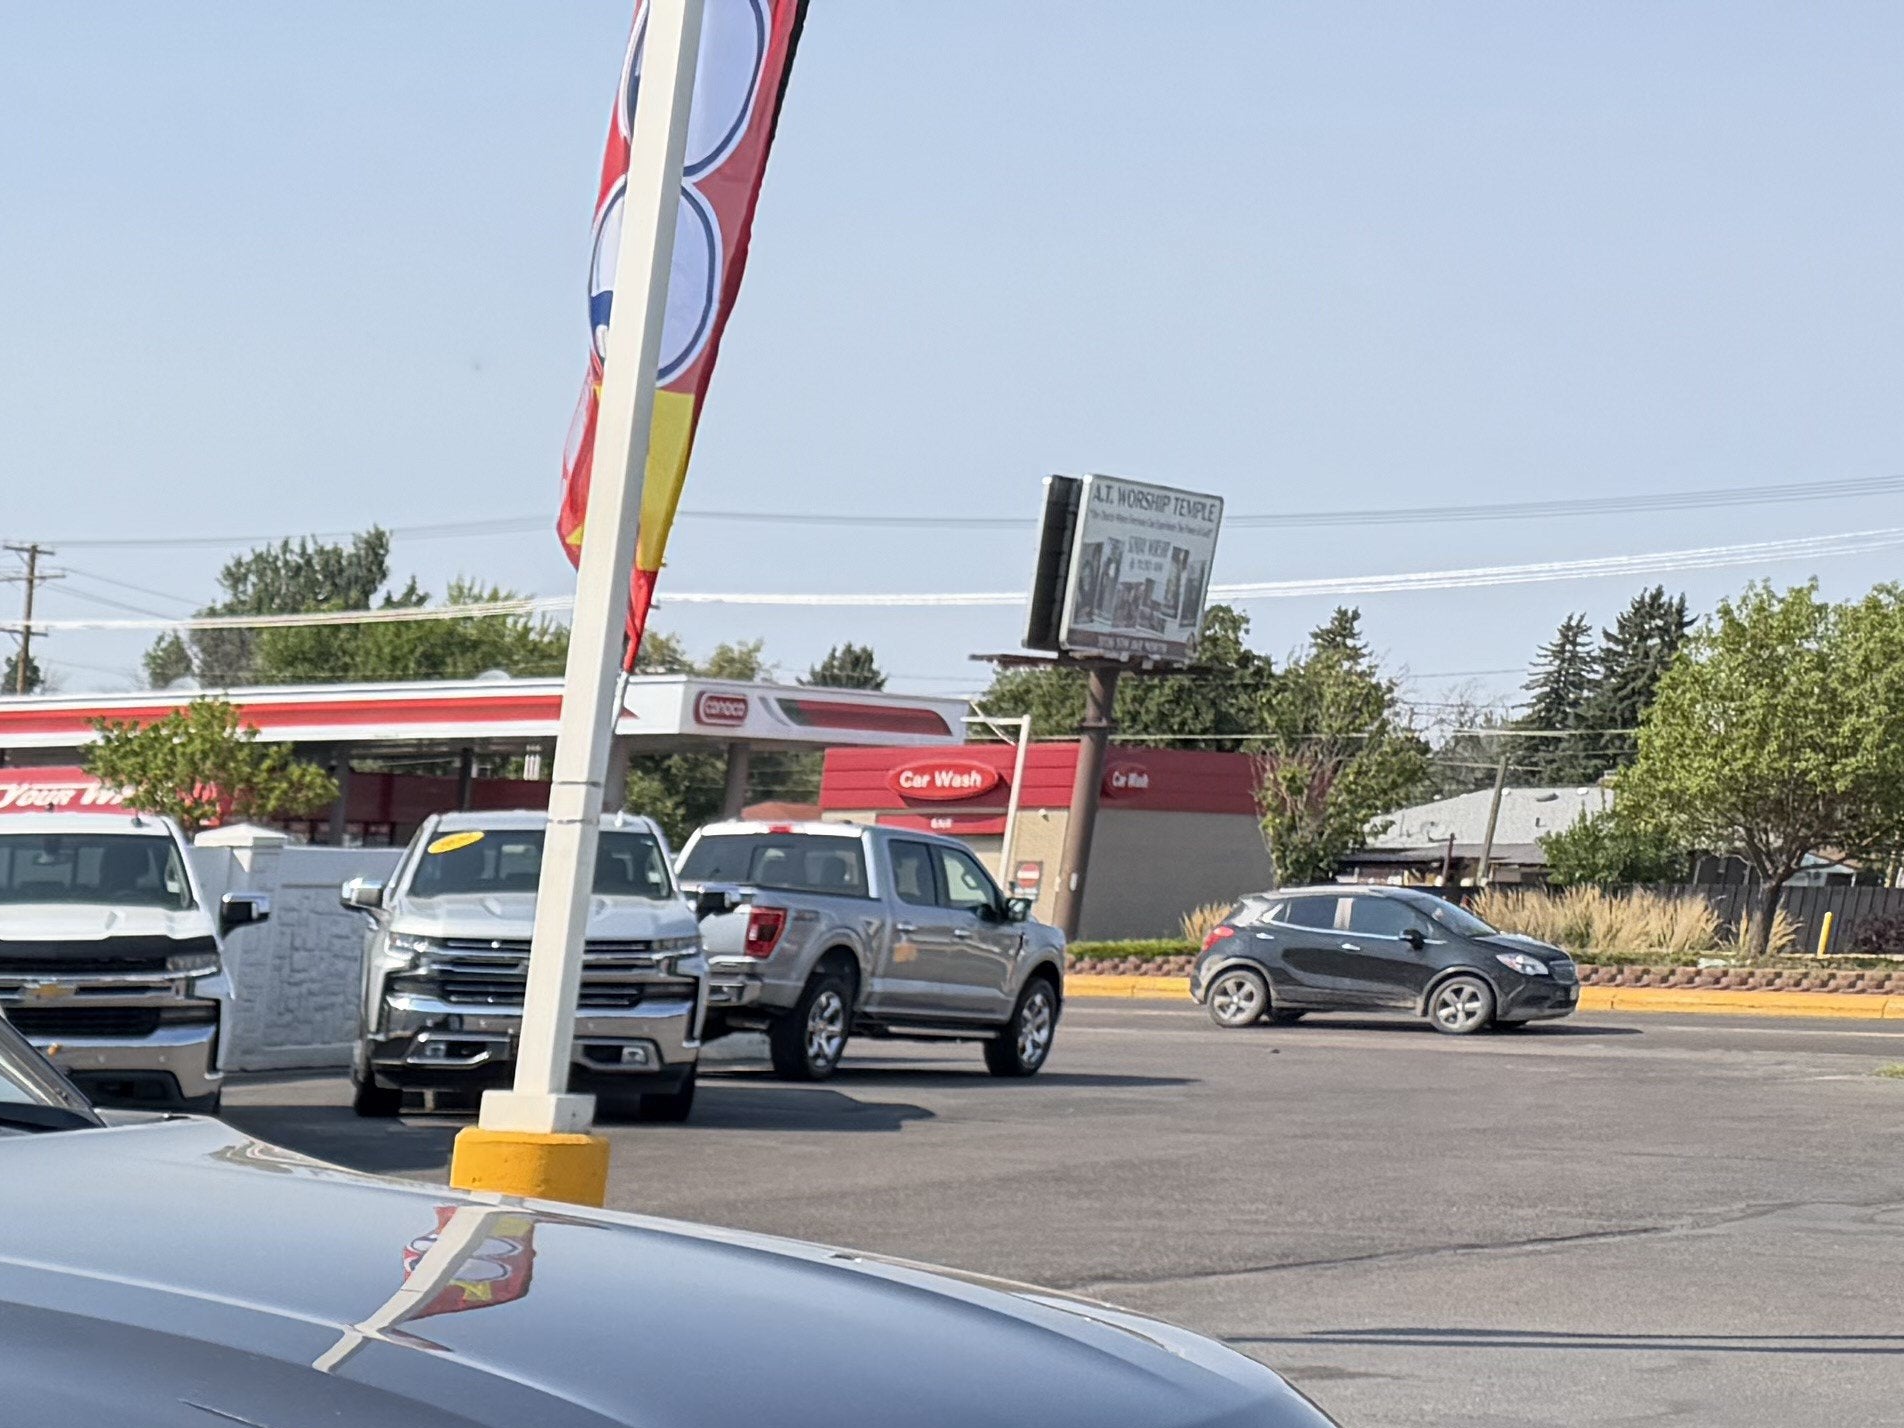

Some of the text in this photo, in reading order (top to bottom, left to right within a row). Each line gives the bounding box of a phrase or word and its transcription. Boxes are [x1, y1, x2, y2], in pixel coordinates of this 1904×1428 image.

[1118, 487, 1171, 513] WORSHIP
[1173, 497, 1217, 522] TEMPLE
[899, 770, 982, 788] Car Wash
